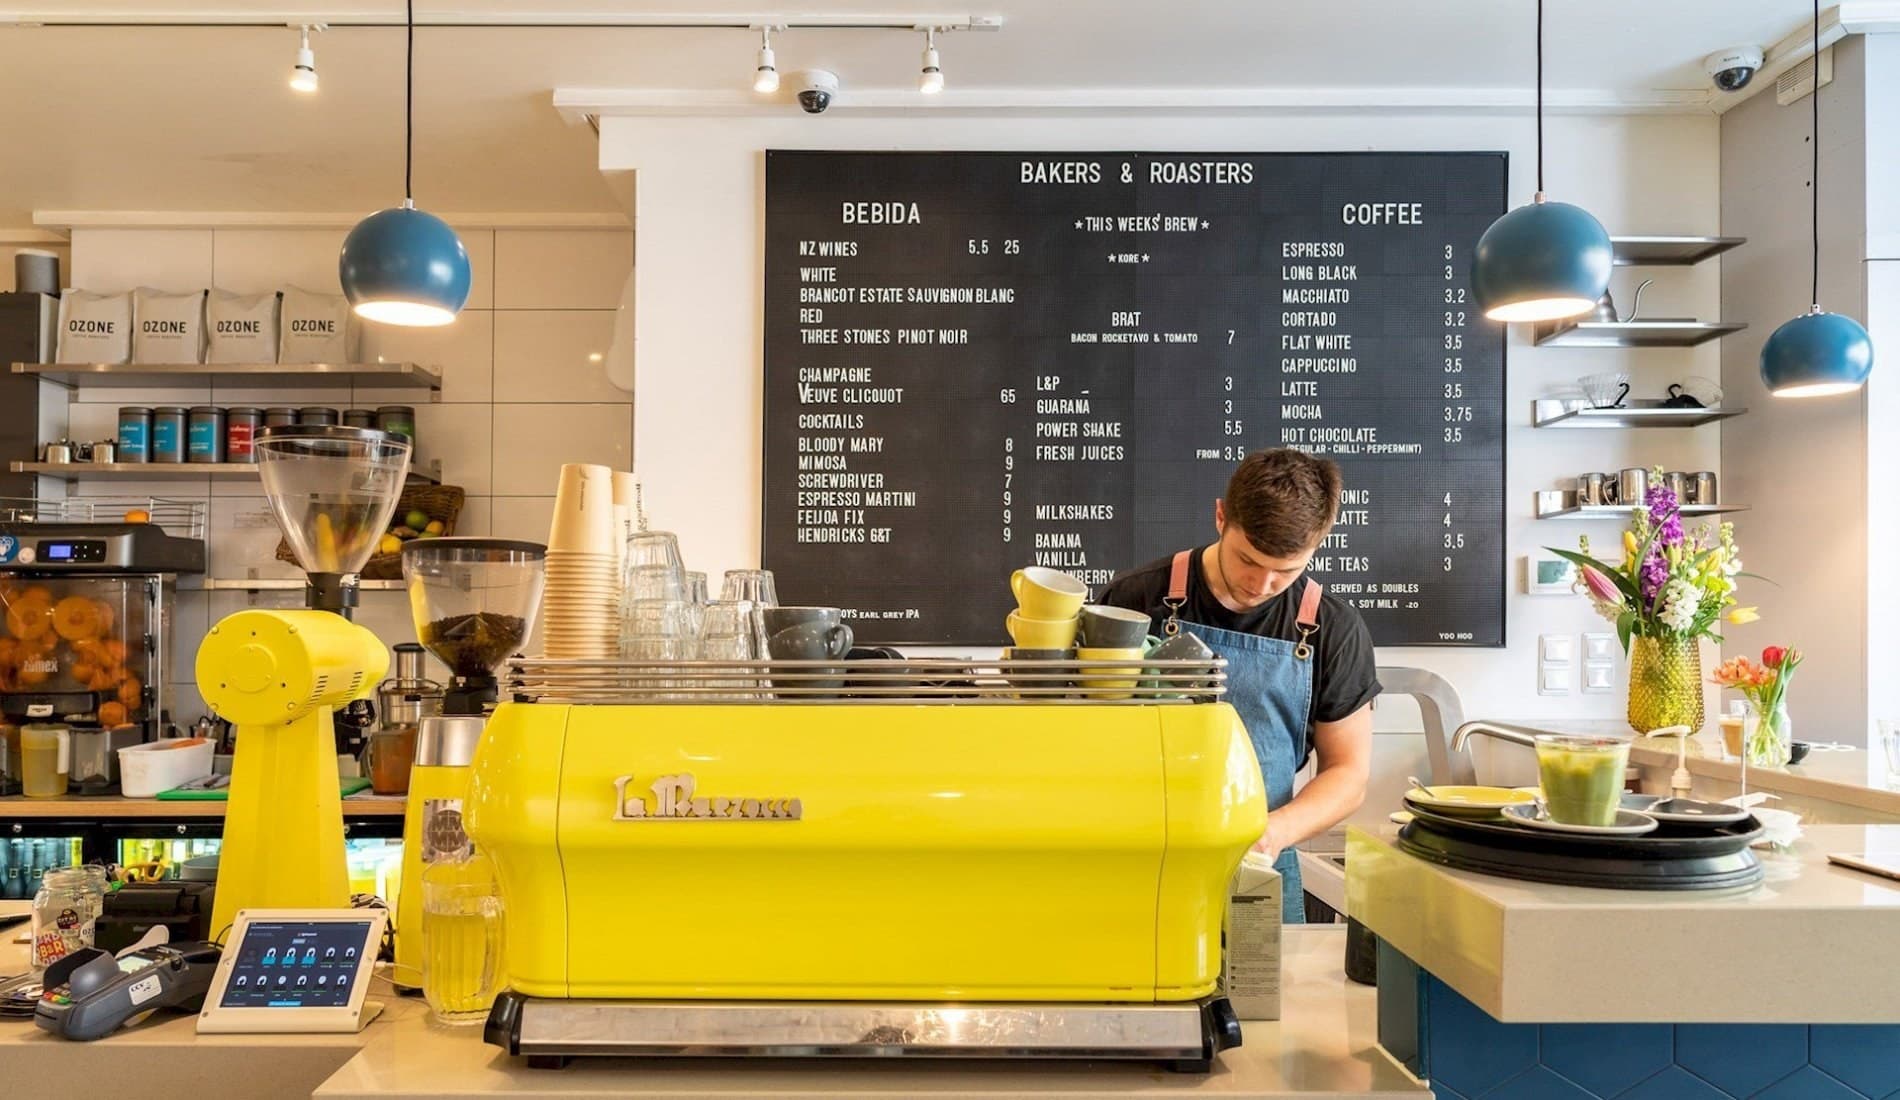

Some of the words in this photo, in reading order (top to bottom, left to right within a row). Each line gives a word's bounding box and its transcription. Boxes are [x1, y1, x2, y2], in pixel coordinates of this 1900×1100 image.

[1021, 162, 1100, 183] BAKERS
[1121, 163, 1132, 183] &
[1151, 162, 1253, 183] ROASTERS
[843, 203, 920, 224] BEBIDA
[1343, 203, 1422, 224] COFFEE
[1085, 217, 1112, 231] THIS
[1165, 217, 1197, 231] BREW
[800, 241, 815, 255] NZ
[819, 242, 857, 256] WINES
[969, 240, 988, 254] 5.5
[1005, 240, 1019, 254] 25
[1283, 243, 1344, 257] ESPRESSO
[1445, 245, 1452, 259] 3
[1119, 254, 1139, 263] KORE
[800, 268, 836, 282] WHITE
[1283, 266, 1313, 280] LONG
[1319, 266, 1356, 280] BLACK
[1445, 265, 1452, 280] 3
[801, 288, 855, 302] BRANCOT
[860, 288, 903, 302] ESTATE
[908, 288, 973, 302] SAUVIGNON
[976, 288, 1014, 303] BLANC
[1283, 289, 1349, 303] MACCHIATO
[1445, 289, 1465, 303] 3.2
[800, 309, 822, 323] RED
[1112, 312, 1141, 326] BRAT
[1283, 312, 1336, 326] CORTADO
[1445, 312, 1464, 326] 3.2
[70, 320, 115, 333] OZONE
[143, 321, 186, 333] OZONE
[217, 321, 260, 332] OZONE
[292, 320, 335, 332] OZONE
[801, 329, 838, 343] THREE
[844, 329, 890, 343] STONES
[898, 330, 934, 343] PINOT
[940, 330, 967, 344] NOIR
[1071, 334, 1097, 342] BACON
[1154, 334, 1160, 342] &
[1164, 333, 1197, 342] TOMATO
[1229, 330, 1234, 344] 7
[1283, 335, 1311, 349] FLAT
[1316, 335, 1351, 349] WHITE
[1445, 335, 1462, 349] 3.5
[1282, 358, 1356, 373] CAPPUCCINO
[1445, 358, 1462, 372] 3.5
[800, 368, 871, 382] CHAMPAGNE
[1037, 376, 1059, 390] L&P
[1225, 377, 1232, 390] 3
[1282, 382, 1317, 396] LATTE
[1445, 384, 1462, 398] 3.5
[843, 389, 903, 403] CLICQUOT
[1001, 389, 1015, 403] 65
[1225, 400, 1232, 414] 3
[1282, 405, 1321, 419] MOCHA
[1445, 407, 1472, 421] 3.75
[799, 414, 863, 428] COCKTAILS
[1037, 423, 1077, 437] POWER
[1083, 423, 1120, 437] SHAKE
[1225, 421, 1242, 435] 5.5
[1282, 428, 1305, 442] HOT
[1310, 428, 1376, 442] CHOCOLATE
[1444, 428, 1461, 442] 3.5
[799, 437, 844, 452] BLOODY
[851, 437, 883, 452] MARY
[1006, 438, 1012, 452] 8
[1333, 444, 1359, 453] CHILLI
[1367, 444, 1421, 454] PEPPERMINT)
[1037, 446, 1074, 460] FRESH
[1082, 446, 1123, 460] JUICES
[1197, 450, 1219, 458] FROM
[1225, 446, 1244, 461] 3.5
[799, 456, 846, 470] MIMOSA
[1006, 456, 1013, 470] 9
[799, 474, 883, 488] SCREWDRIVER
[1005, 474, 1011, 488] 7
[799, 492, 860, 506] ESPRESSO
[866, 492, 915, 506] MARTINI
[1004, 491, 1011, 505] 9
[1341, 490, 1369, 505] ONIC
[1444, 492, 1451, 506] 4
[798, 510, 838, 524] FEIJOA
[845, 510, 864, 524] FIX
[1004, 509, 1011, 524] 9
[1036, 505, 1113, 519] MILKSHAKES
[1444, 513, 1451, 527] 4
[798, 528, 864, 542] HENDRICKS
[871, 528, 891, 542] G&T
[1004, 528, 1010, 542] 9
[1036, 534, 1081, 548] BANANA
[1319, 534, 1348, 548] ATTE
[1445, 534, 1463, 548] 3.5
[1036, 552, 1086, 566] VANILLA
[1339, 557, 1368, 571] TEAS
[1444, 557, 1451, 571] 3
[1331, 584, 1362, 593] SERVED
[1367, 584, 1377, 592] AS
[1383, 584, 1418, 593] DOUBLES
[1359, 600, 1374, 608] SOY
[1377, 599, 1398, 608] MILK
[906, 609, 919, 618] IPA
[612, 775, 647, 820] La
